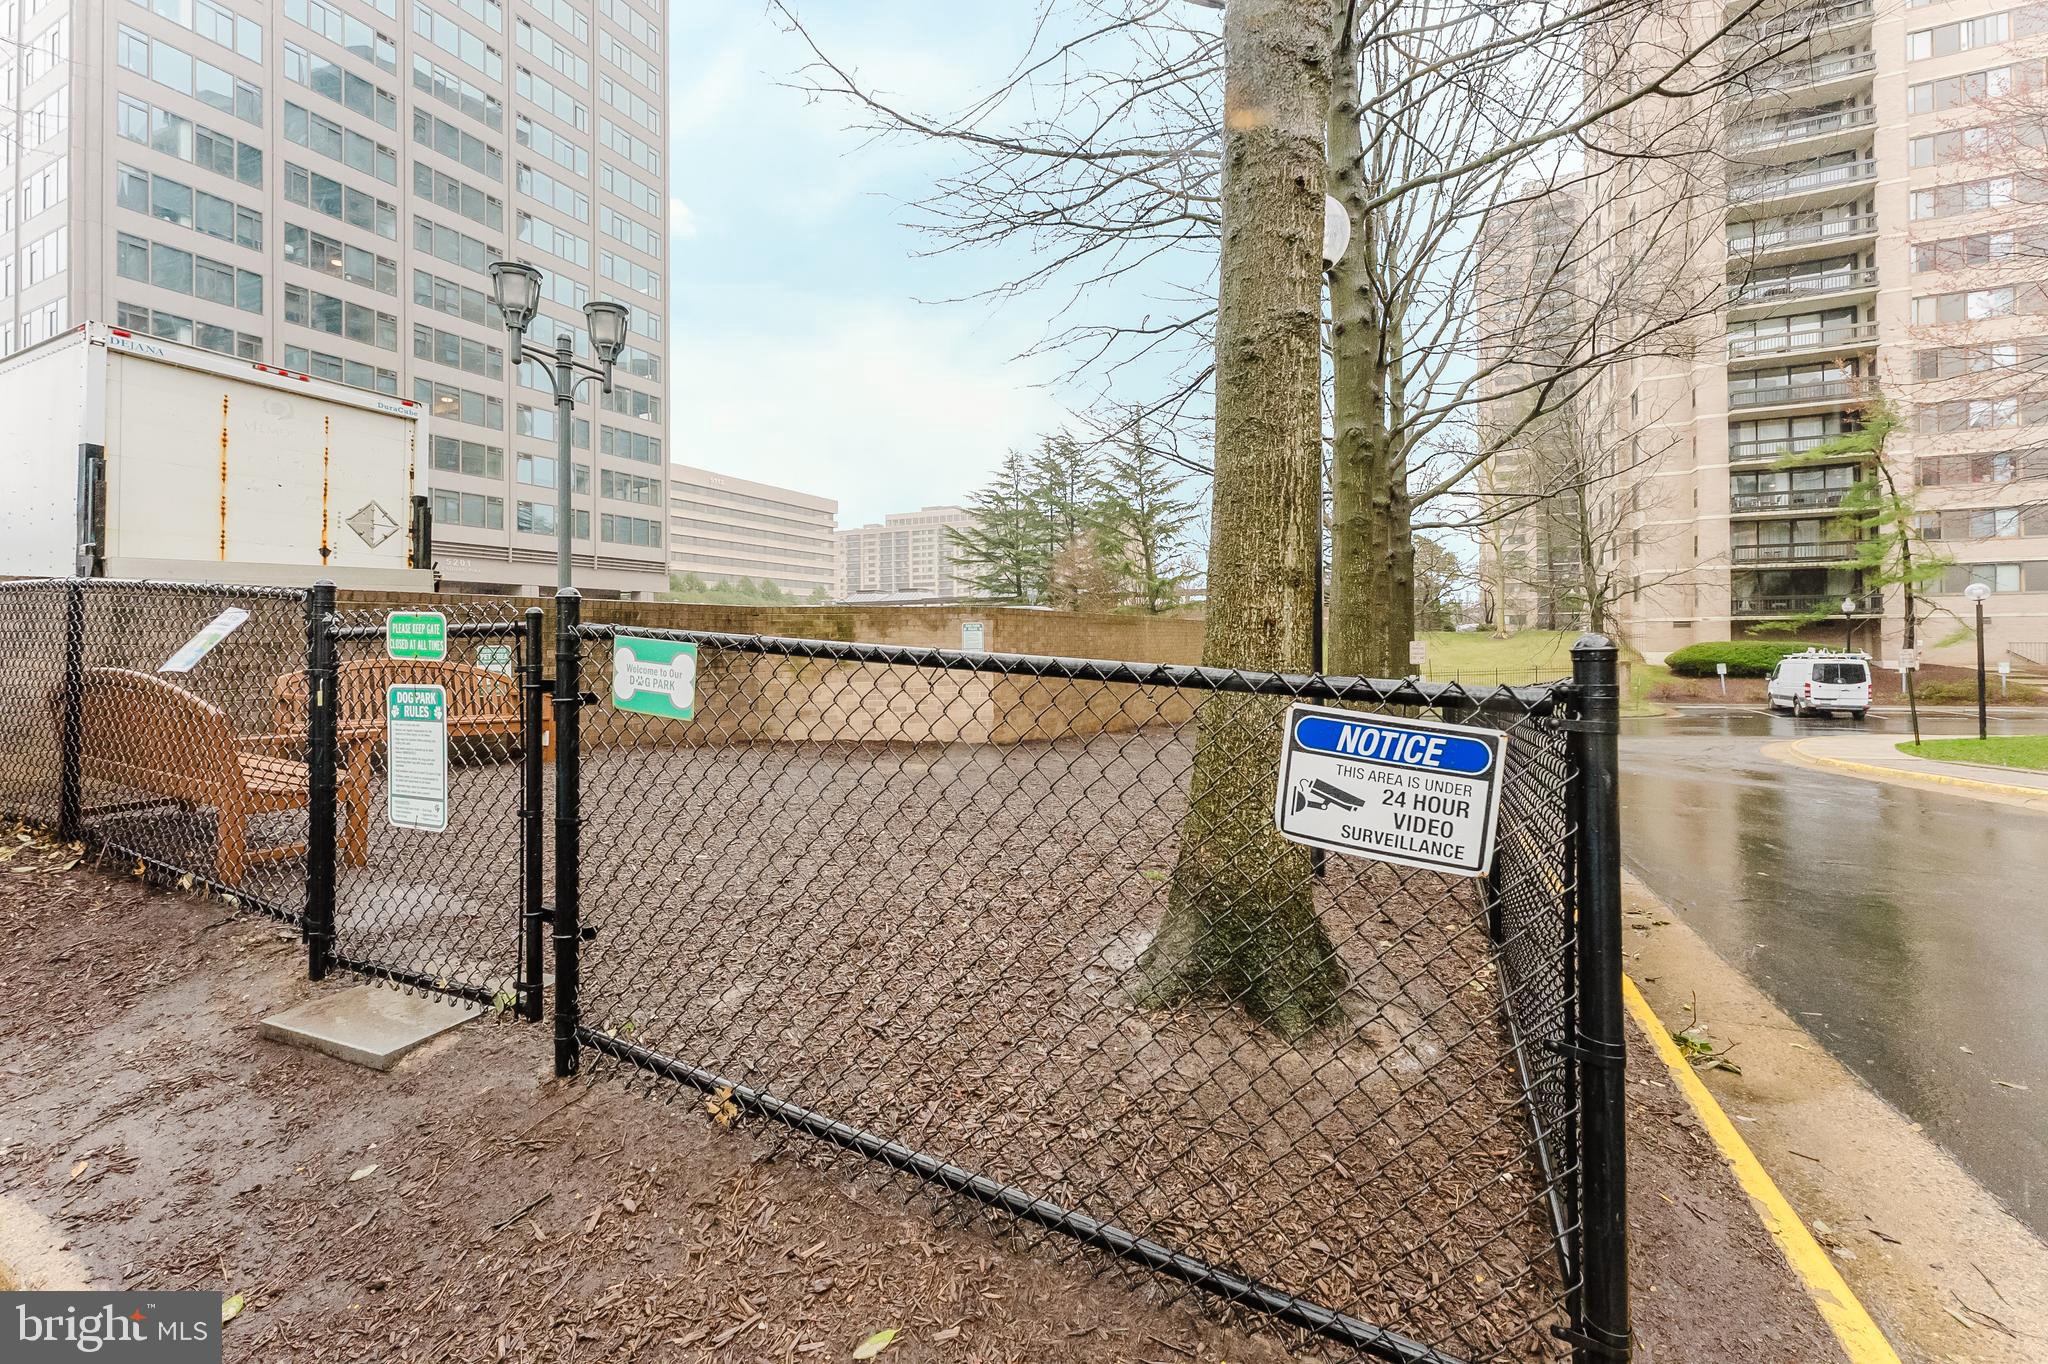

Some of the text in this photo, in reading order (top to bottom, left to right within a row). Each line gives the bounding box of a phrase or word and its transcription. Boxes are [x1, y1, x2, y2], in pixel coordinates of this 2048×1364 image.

[110, 336, 164, 356] DEJANA
[377, 402, 418, 416] DuraCube
[392, 623, 441, 635] PLEASE KEEP GATE
[390, 639, 444, 651] CLOSED AT ALL TIMES
[626, 663, 683, 679] Welcome to Our
[652, 678, 675, 691] PARK
[396, 691, 437, 704] DOG PARK
[403, 705, 430, 718] RULES
[1335, 724, 1447, 767] NOTICE
[1336, 763, 1473, 798] THIS AREA IS UNDER
[1382, 788, 1470, 819] 24 HOUR
[1393, 812, 1454, 839] VIDEO
[1340, 824, 1465, 860] SURVEILLANCE
